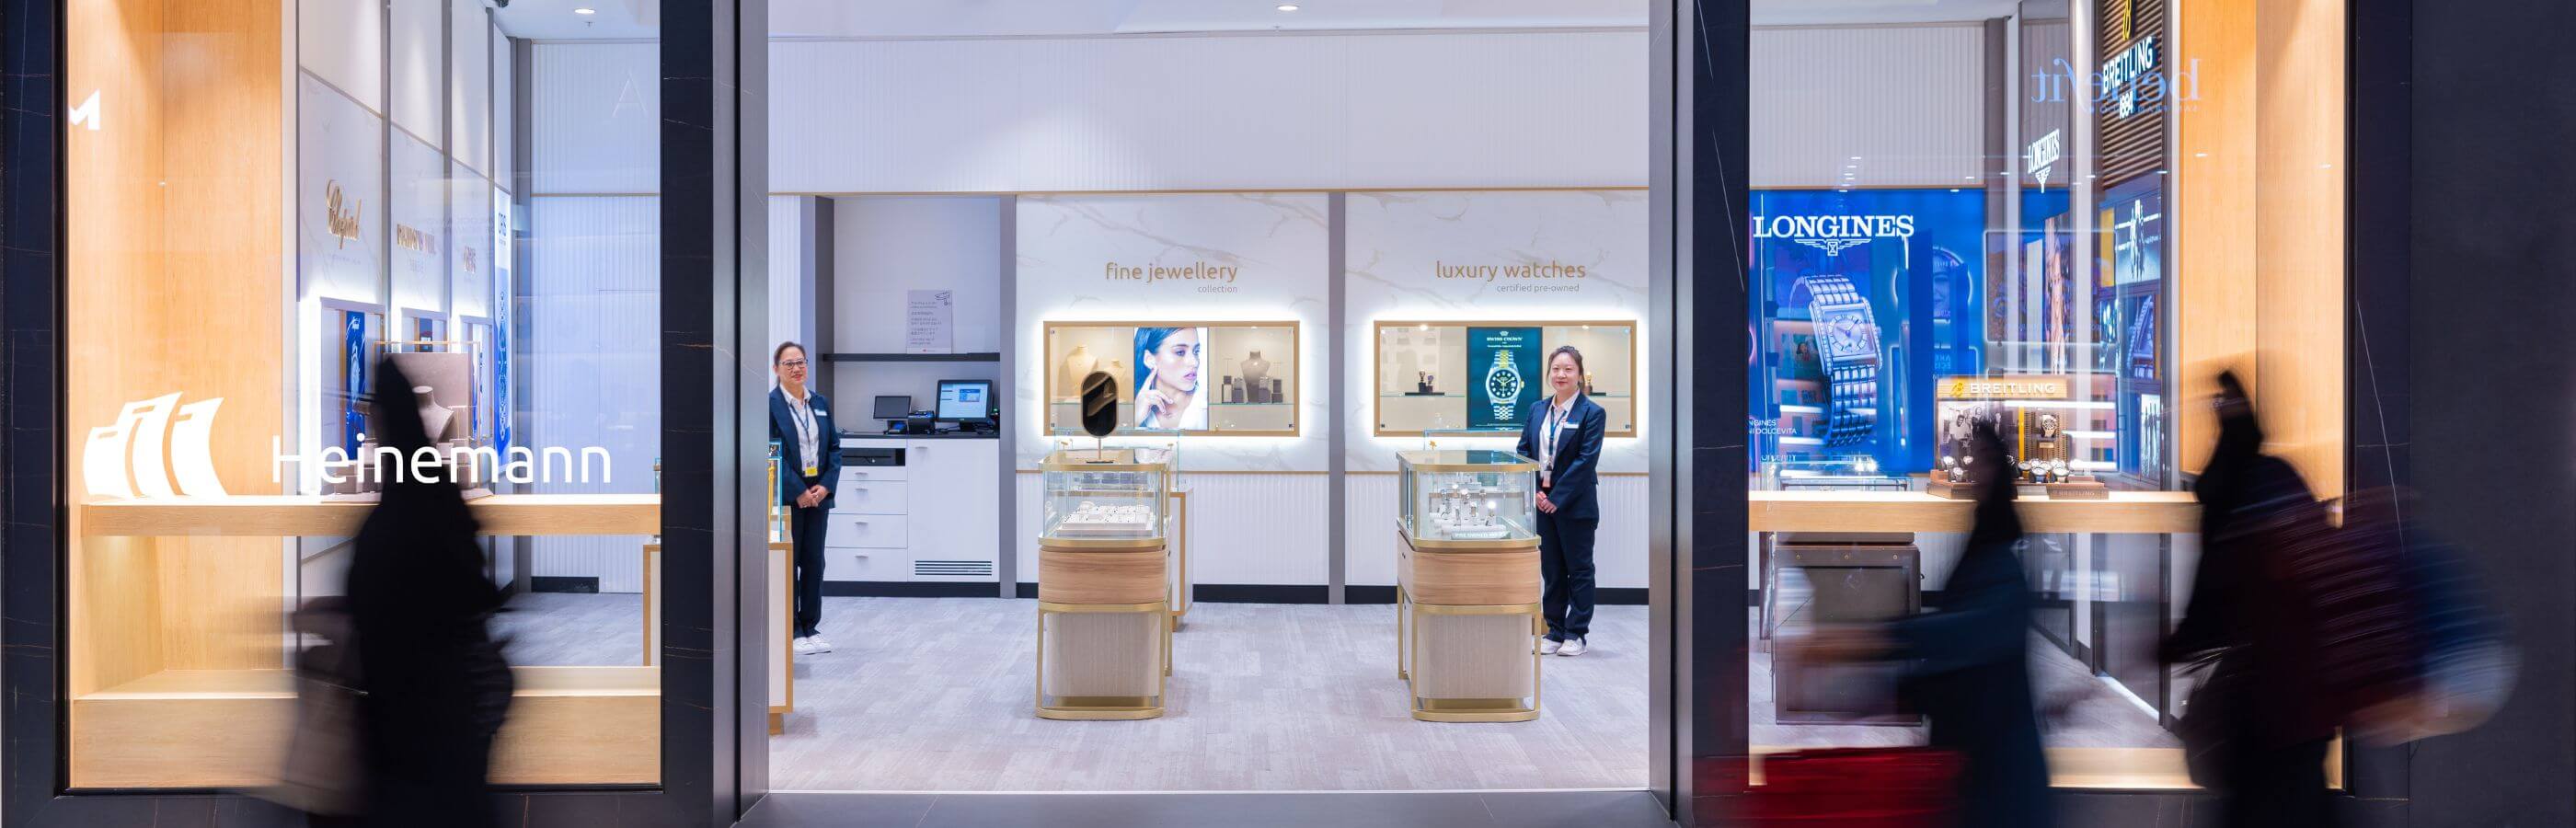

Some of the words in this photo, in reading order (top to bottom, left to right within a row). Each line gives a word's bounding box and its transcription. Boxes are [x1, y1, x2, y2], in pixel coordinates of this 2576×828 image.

[2103, 36, 2154, 94] BREITLING
[2028, 129, 2060, 174] LONGINES
[1753, 215, 1915, 238] LONGINES
[1106, 261, 1143, 280] fine
[1147, 261, 1237, 283] jewellery
[1436, 260, 1498, 282] luxury
[1503, 260, 1586, 279] watches
[1197, 285, 1237, 293] collection
[1497, 283, 1532, 293] certified
[1534, 283, 1580, 293] pre-owned
[1970, 383, 2055, 395] BREITLING
[272, 432, 611, 484] Heinemann
